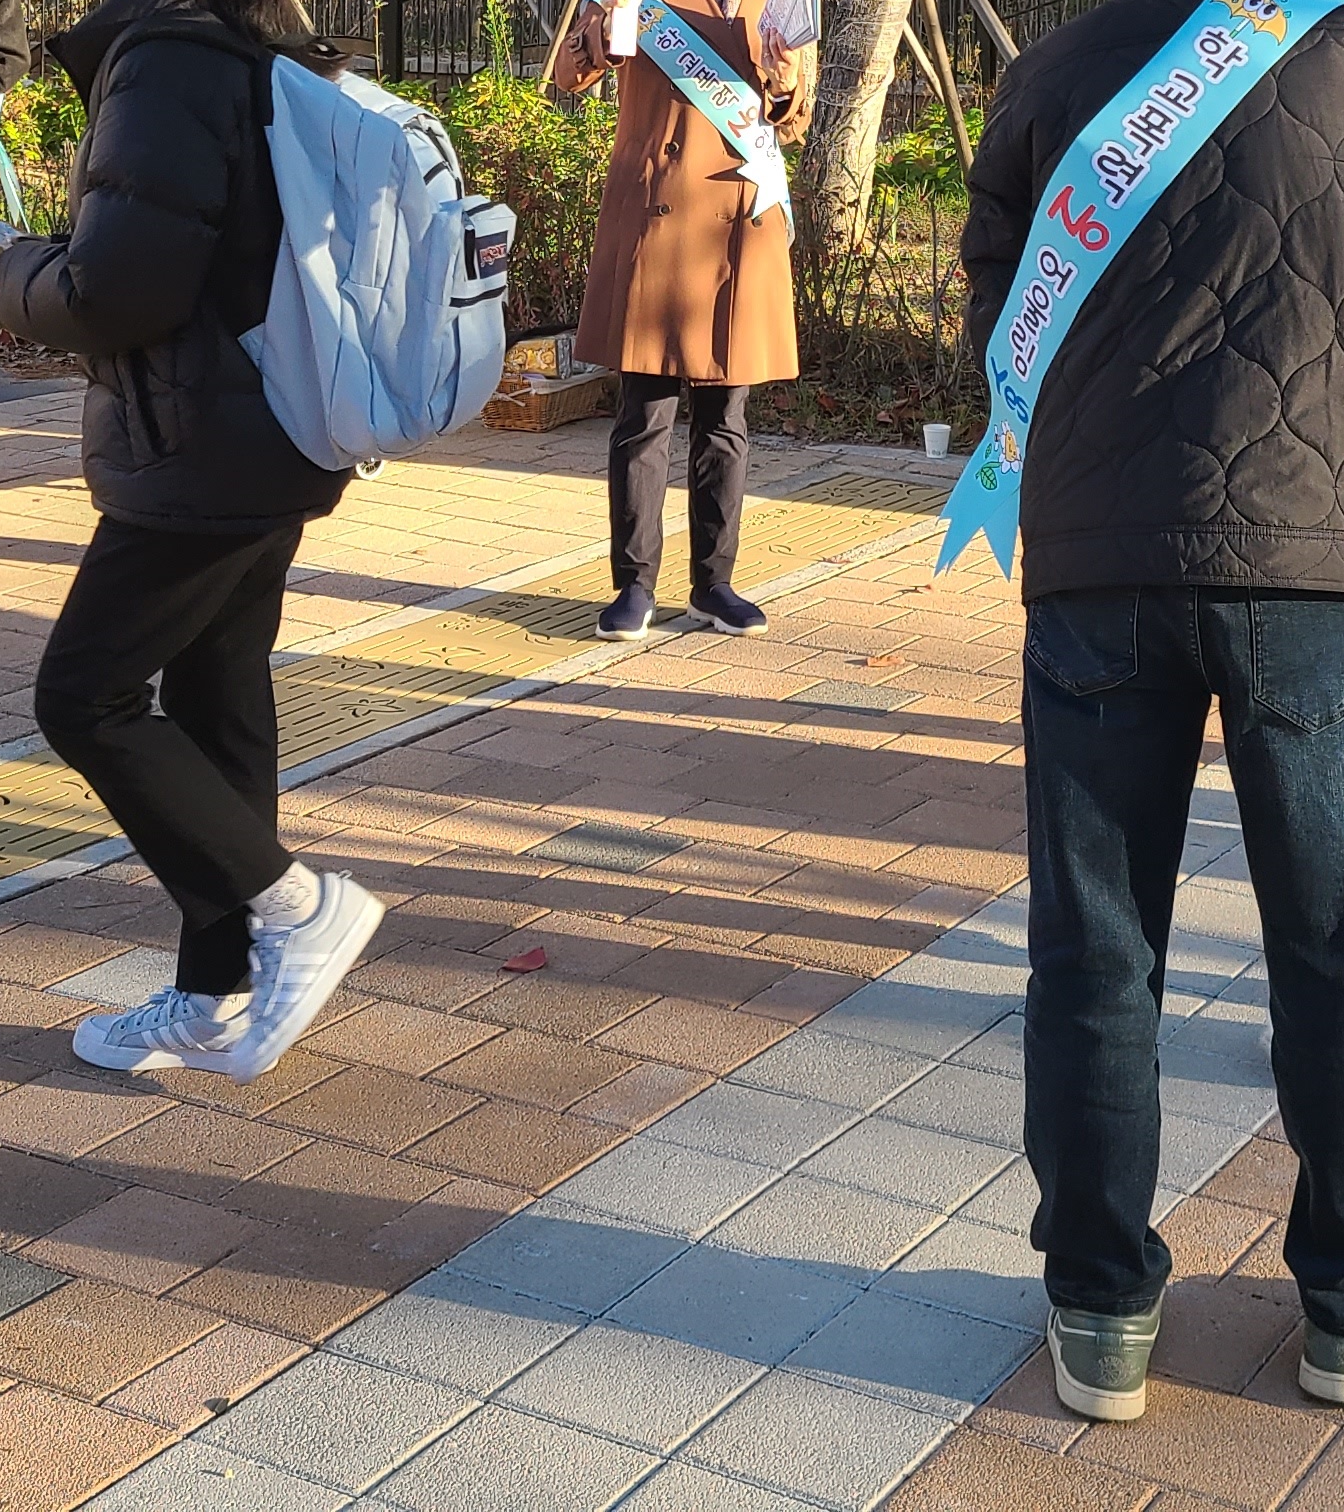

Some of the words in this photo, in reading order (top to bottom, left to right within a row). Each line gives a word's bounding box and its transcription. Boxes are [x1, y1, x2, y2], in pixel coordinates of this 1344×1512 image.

[655, 27, 740, 107] 학교폭력
[1094, 28, 1246, 207] 학교폭력
[1011, 245, 1076, 380] 어울림
